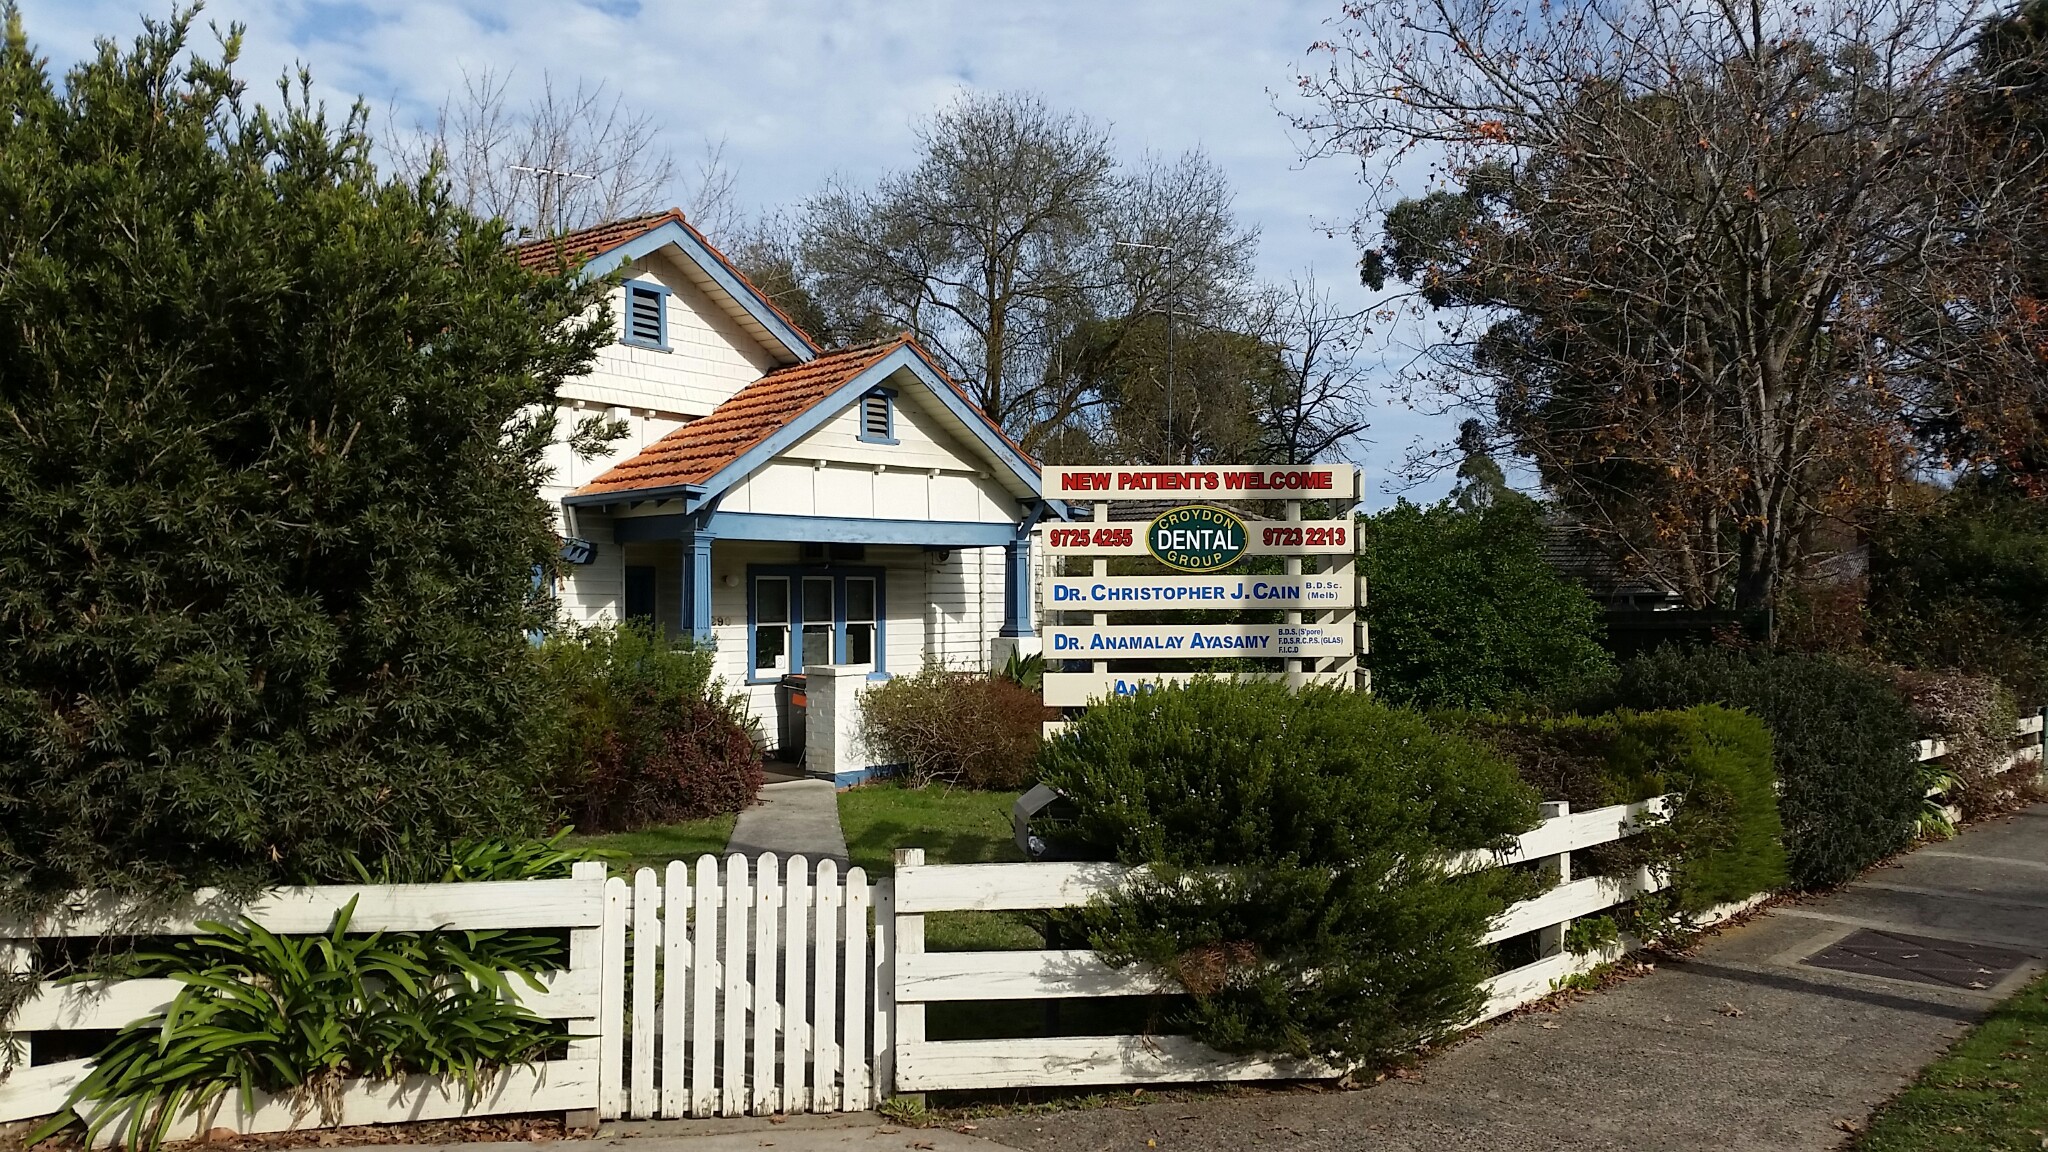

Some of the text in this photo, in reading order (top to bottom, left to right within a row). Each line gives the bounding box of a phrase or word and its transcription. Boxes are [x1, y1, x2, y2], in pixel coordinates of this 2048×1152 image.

[1061, 472, 1333, 491] NEW PATIENTS WELCOME
[1158, 509, 1235, 530] CROYDON
[1050, 529, 1134, 547] 9725 4255
[1157, 529, 1239, 550] DENTAL
[1263, 527, 1346, 546] 9723 2213
[1167, 550, 1222, 568] GROUP
[1091, 584, 1226, 601] CHRISTOPHER
[1230, 583, 1250, 600] J.
[1253, 582, 1300, 600] CAIN
[1305, 581, 1342, 590] B.D.Sc.
[1307, 591, 1338, 600] (Melb)
[1090, 633, 1184, 650] ANAMALAY
[1190, 632, 1270, 649] AYASAMY
[1278, 628, 1324, 637] B.D.S. (S'pore)
[1320, 636, 1344, 645] (GLAS)
